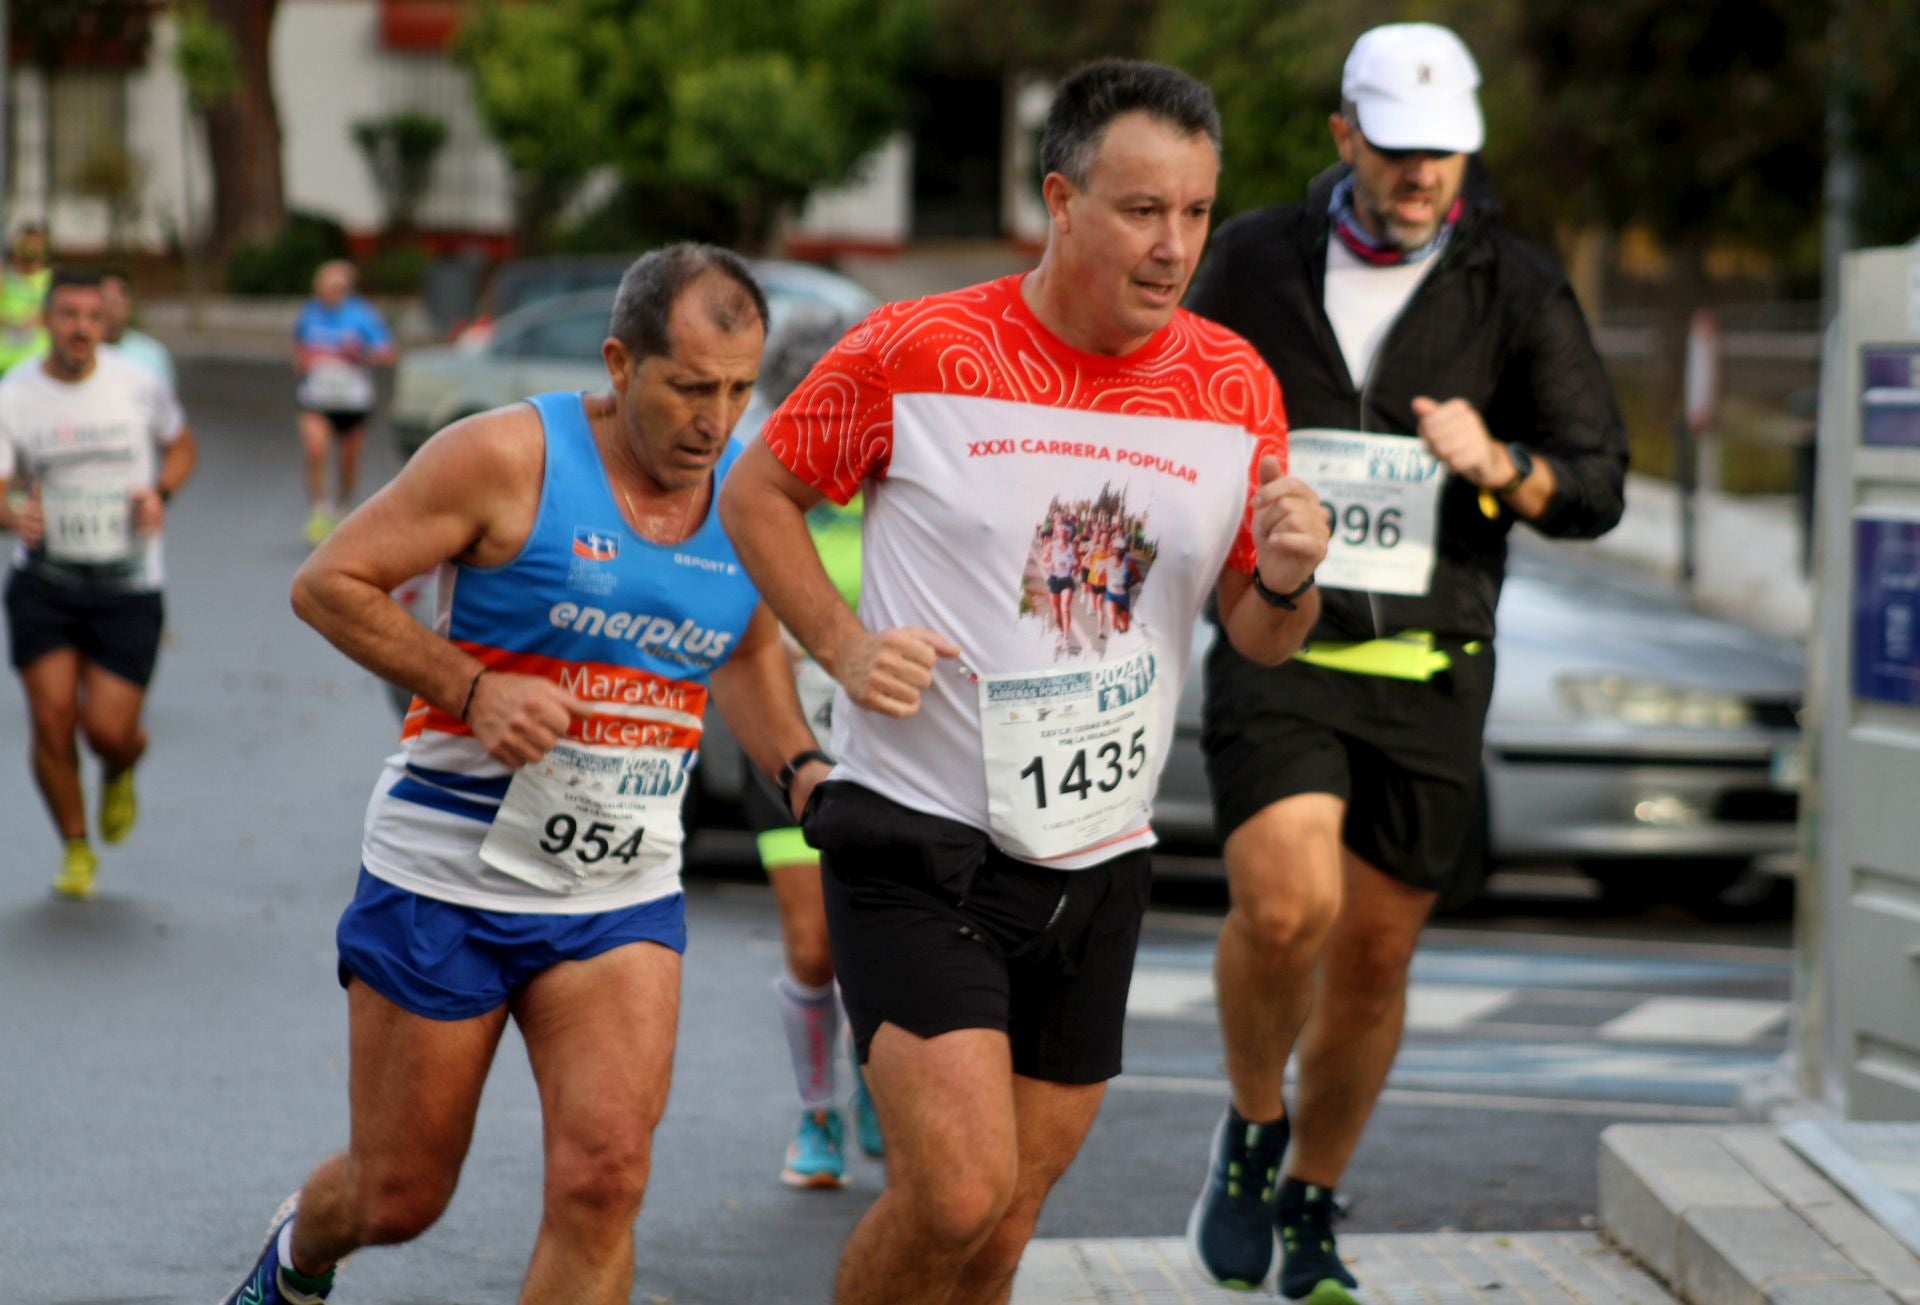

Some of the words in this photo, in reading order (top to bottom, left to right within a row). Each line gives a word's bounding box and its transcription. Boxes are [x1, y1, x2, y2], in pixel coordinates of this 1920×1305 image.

[967, 439, 1015, 458] XXXI
[1020, 439, 1112, 462] CARRERA
[1116, 449, 1199, 484] POPULAR
[549, 602, 733, 658] enerplus
[566, 719, 673, 747] ucena
[1020, 726, 1147, 809] 1435
[539, 813, 645, 865] 954
